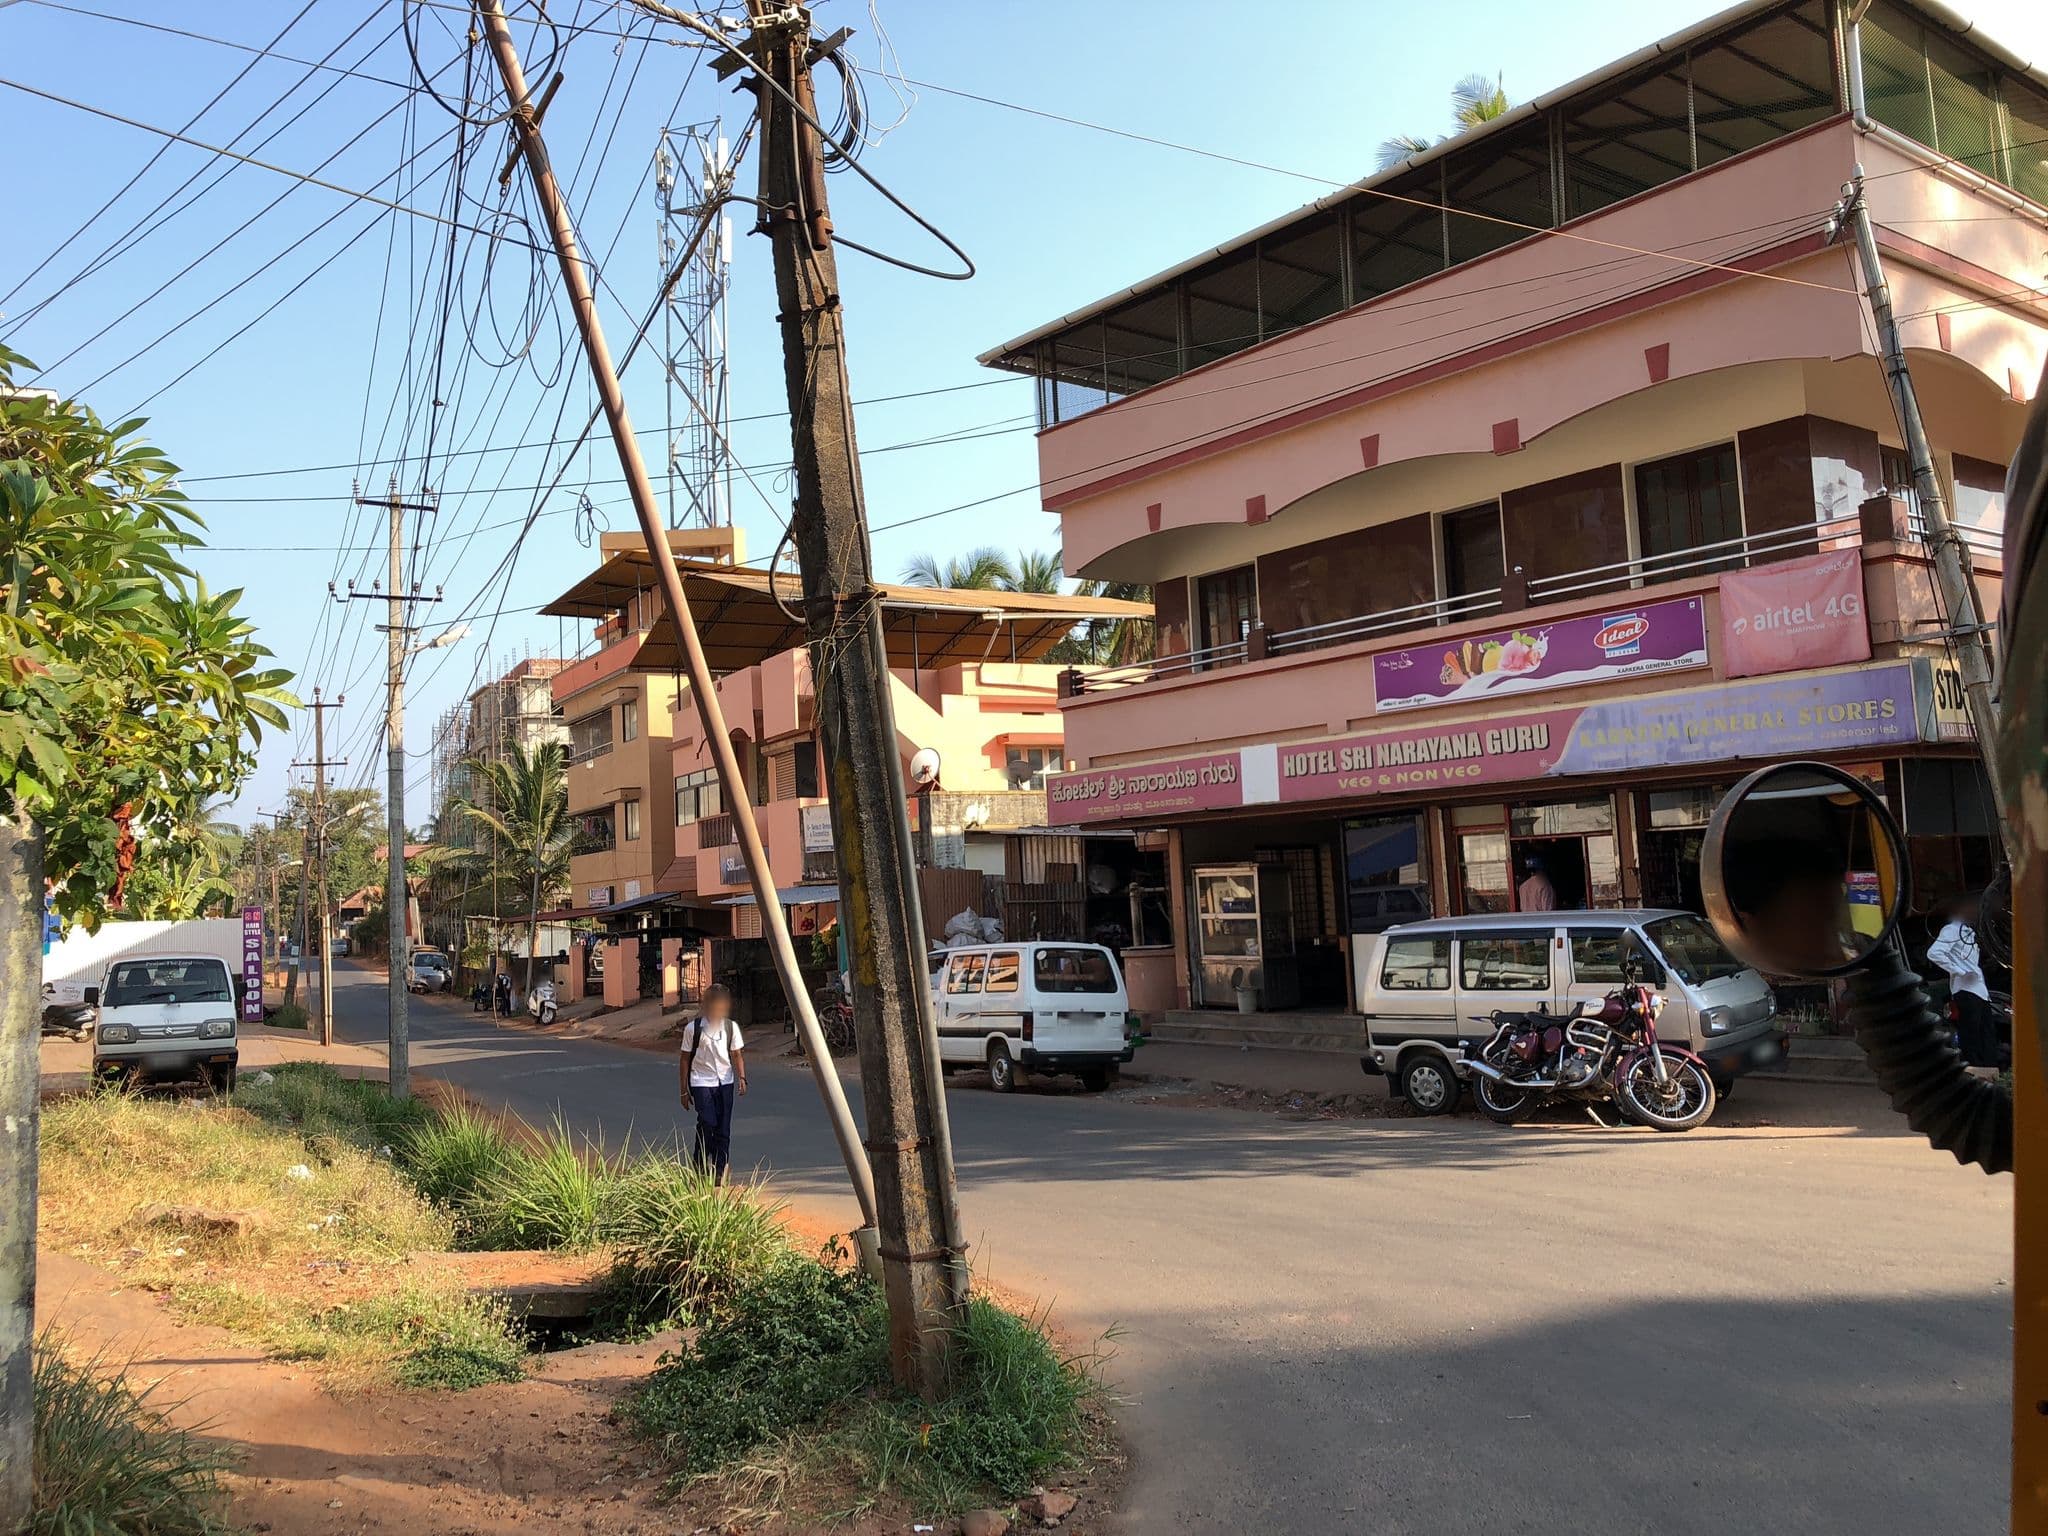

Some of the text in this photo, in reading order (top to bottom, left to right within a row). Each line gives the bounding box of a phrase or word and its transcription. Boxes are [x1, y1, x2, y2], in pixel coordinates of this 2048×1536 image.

[1602, 620, 1642, 645] Ideal
[1753, 593, 1859, 632] airtel 4G
[1617, 658, 1693, 674] KARKERA GENERAL STORE
[1580, 721, 1679, 747] KARKERA
[1685, 710, 1786, 737] GENERAL
[1797, 698, 1896, 726] STORES
[1283, 723, 1550, 777] HOTEL SRI NARAYANA GURU
[1052, 759, 1238, 803] ಹೋಟೆಲ್ ಶ್ರೀ ನಾರಾಯಣ ಗುರು
[1338, 764, 1482, 790] VEG & NON VEG
[245, 938, 260, 1014] SALOON
